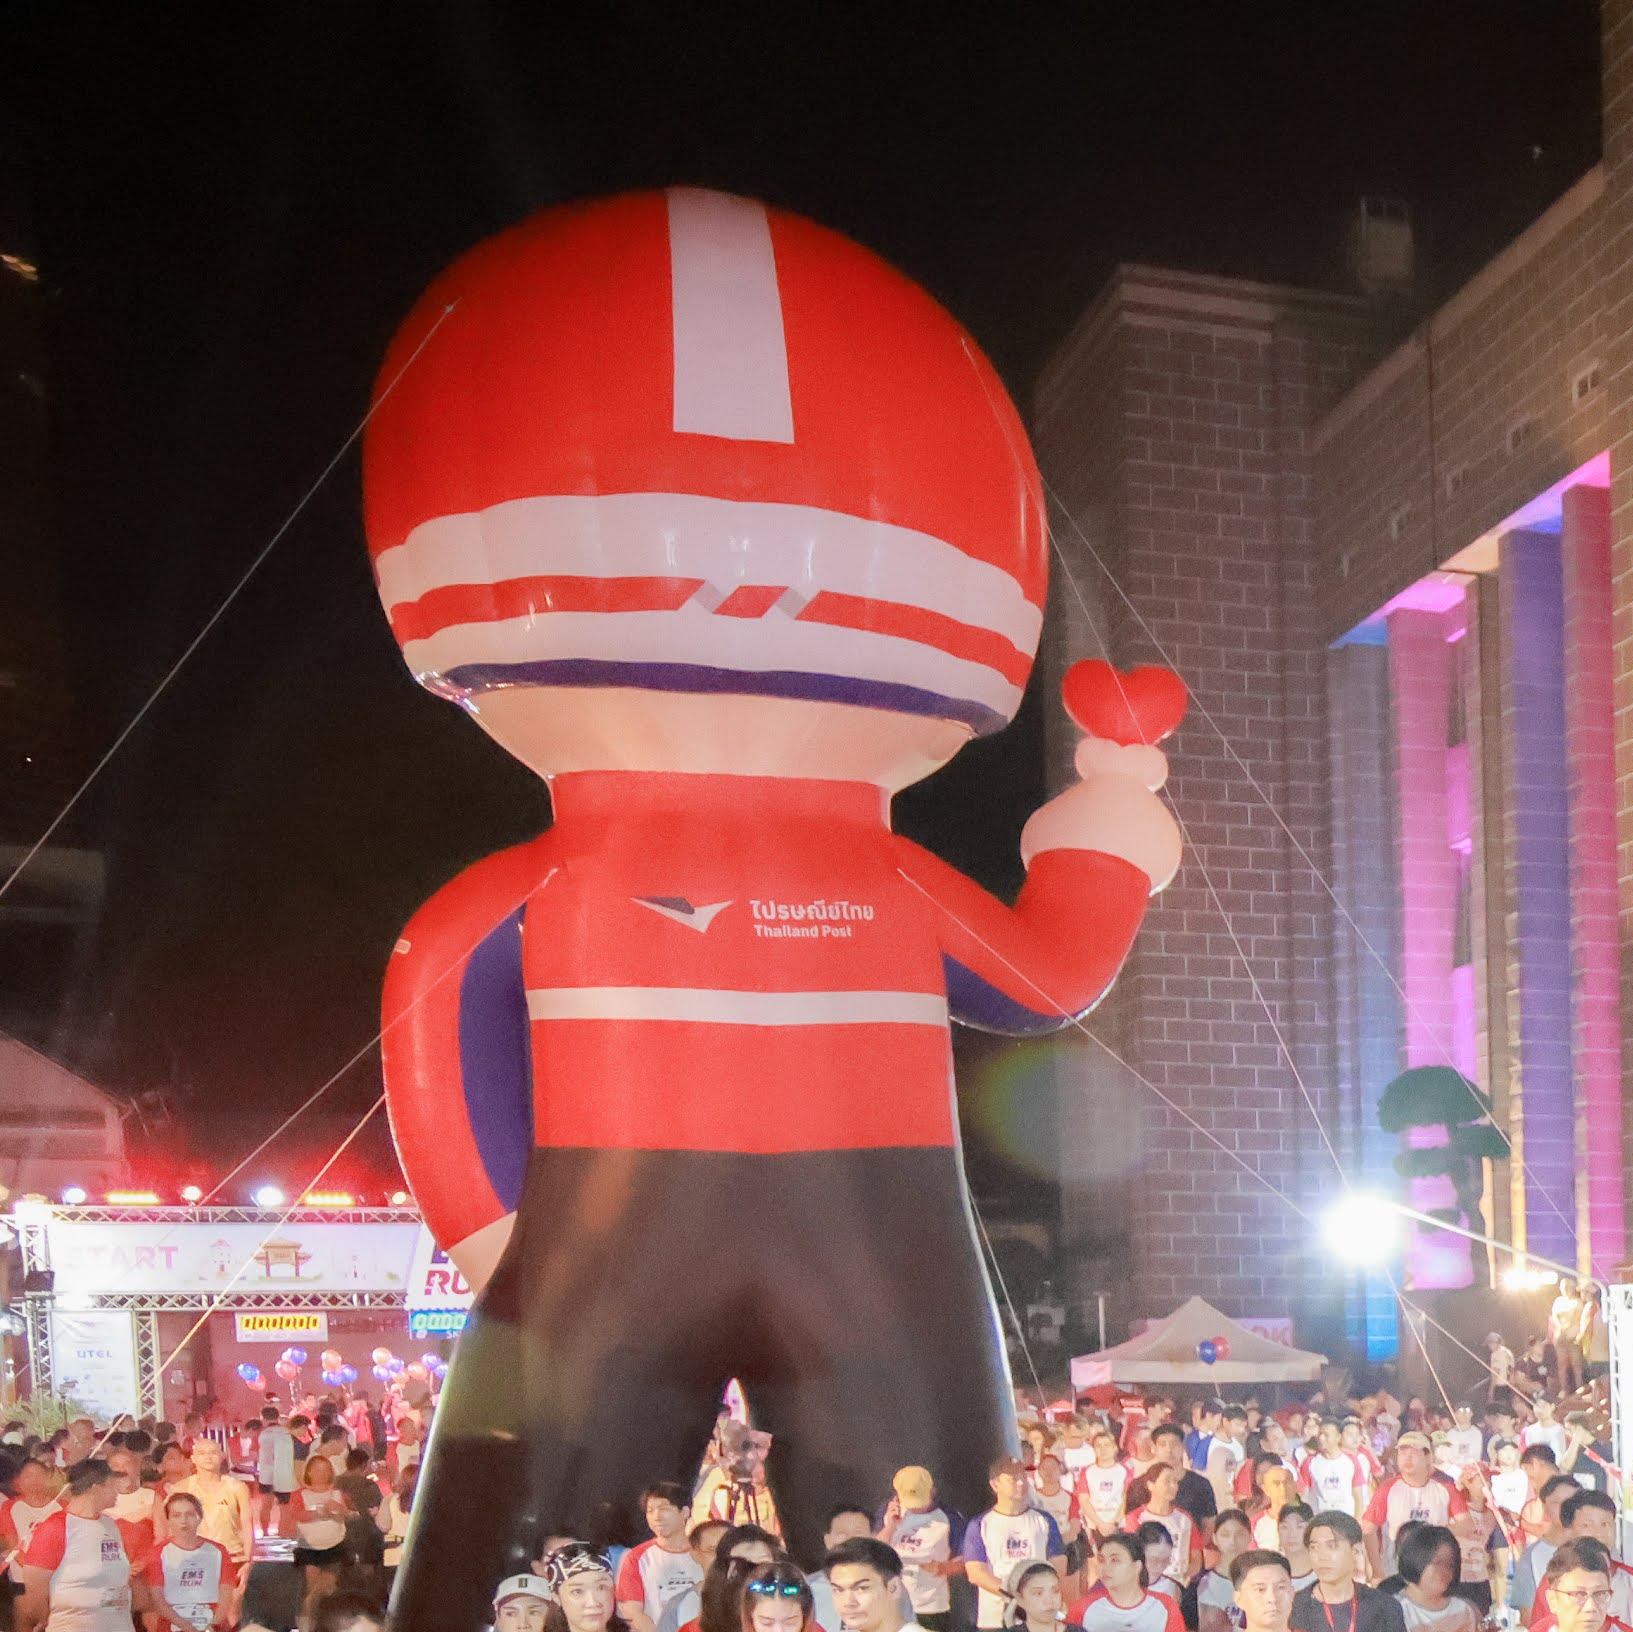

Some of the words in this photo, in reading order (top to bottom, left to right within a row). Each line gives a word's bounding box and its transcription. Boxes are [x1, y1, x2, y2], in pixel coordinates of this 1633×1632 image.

[749, 899, 875, 921] ไปรษณีย์ไทย
[753, 924, 819, 938] Thailand
[821, 924, 852, 938] Post
[424, 1269, 470, 1295] RU
[77, 1350, 112, 1358] UTEL
[181, 1570, 204, 1580] EMS
